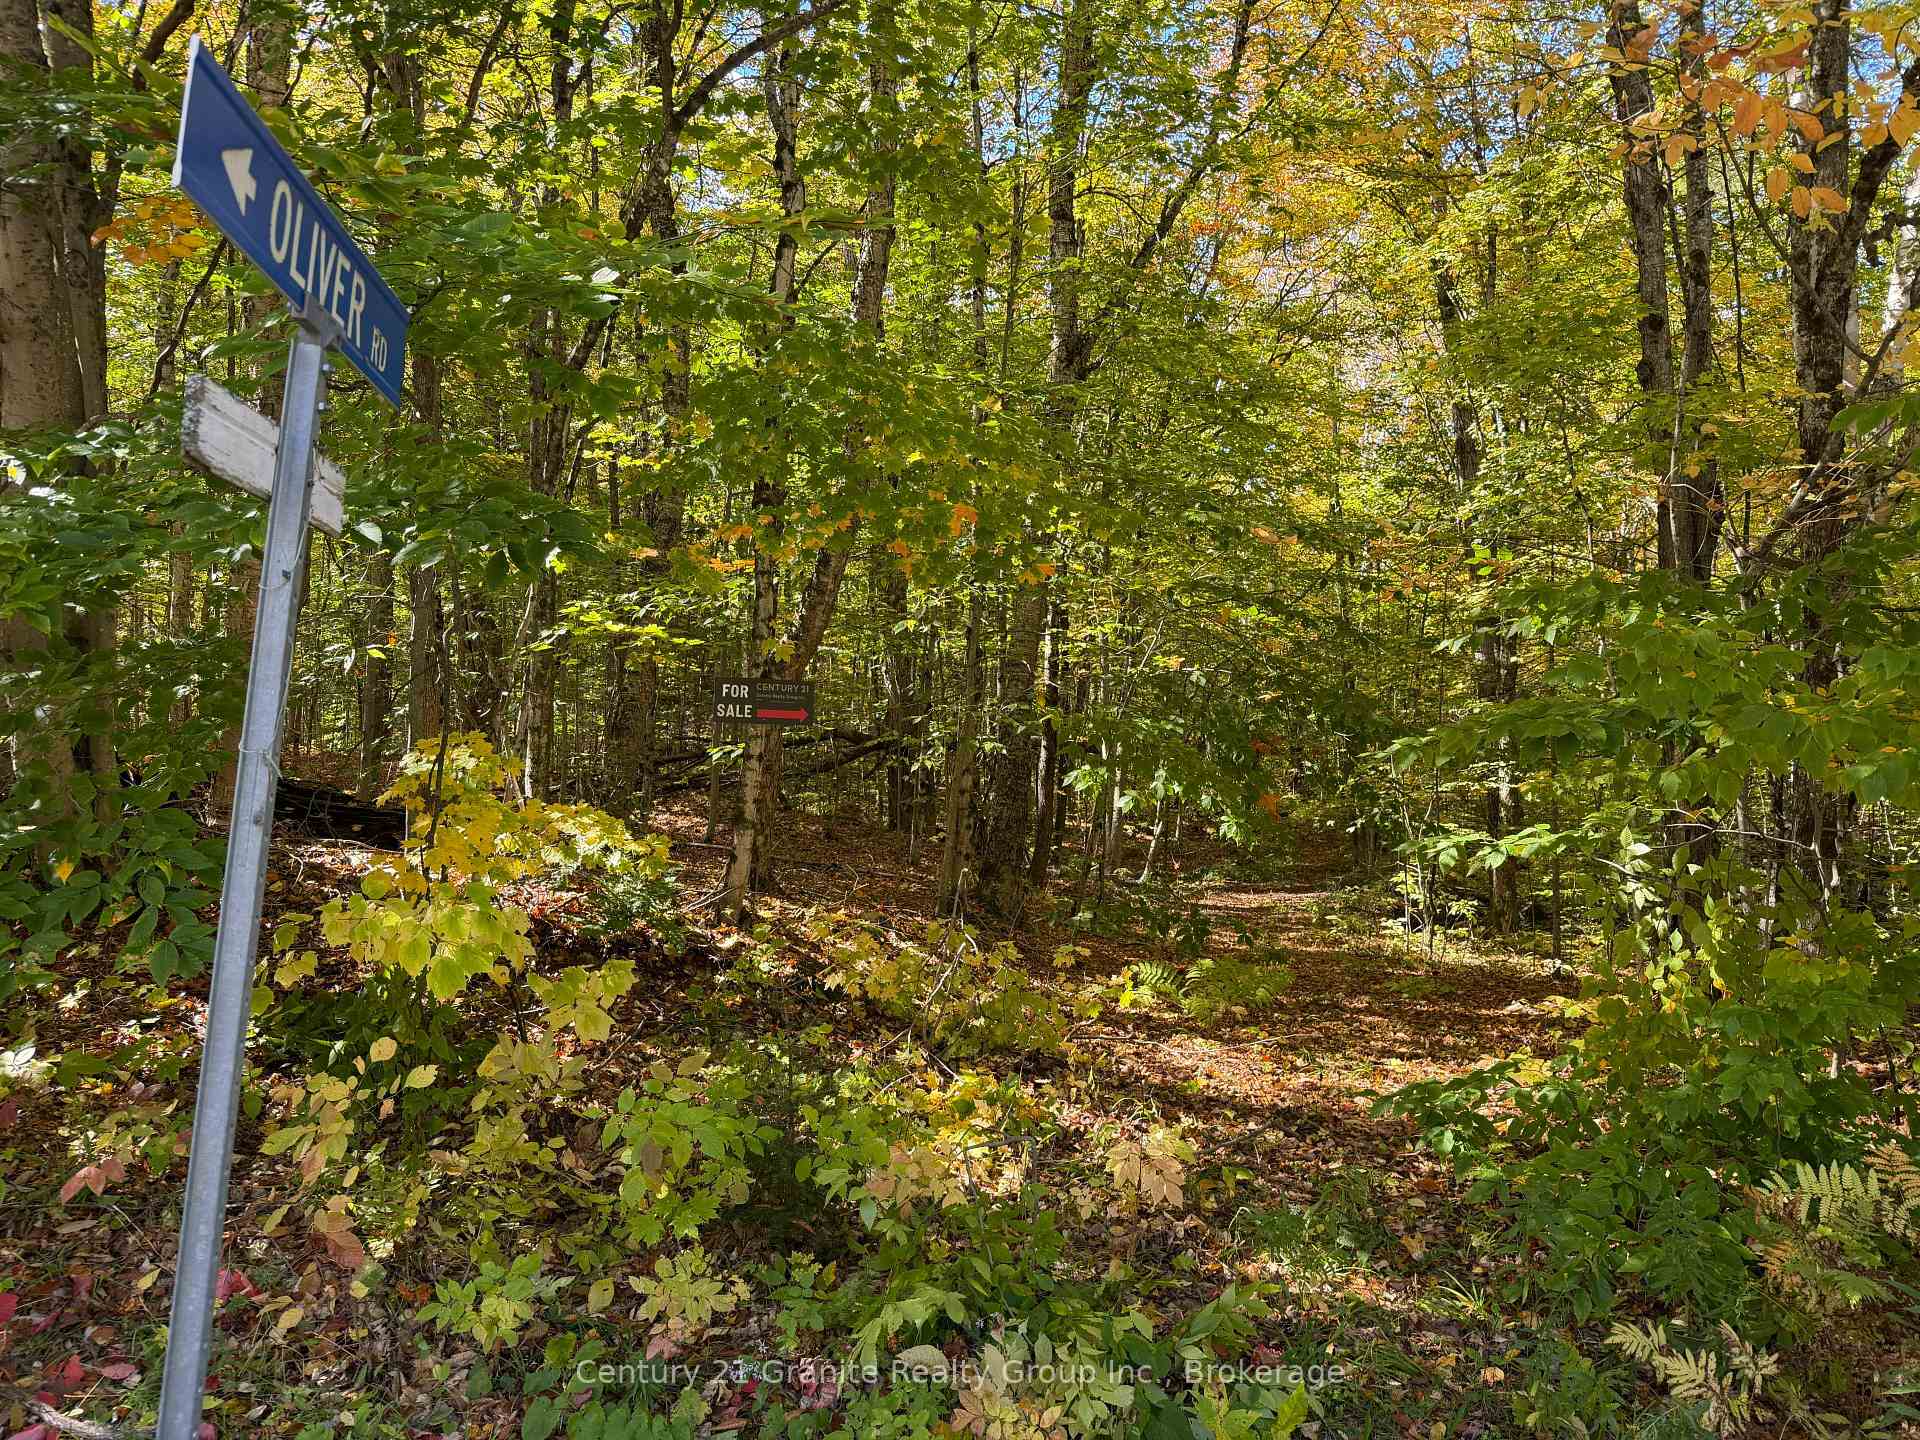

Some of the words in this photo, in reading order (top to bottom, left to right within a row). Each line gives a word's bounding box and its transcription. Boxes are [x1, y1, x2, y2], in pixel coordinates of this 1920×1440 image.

[270, 179, 366, 349] OLIVER
[371, 326, 388, 372] RD
[722, 684, 748, 698] FOR
[756, 683, 799, 693] CENTURY
[800, 684, 809, 693] 21
[716, 703, 752, 718] SALE
